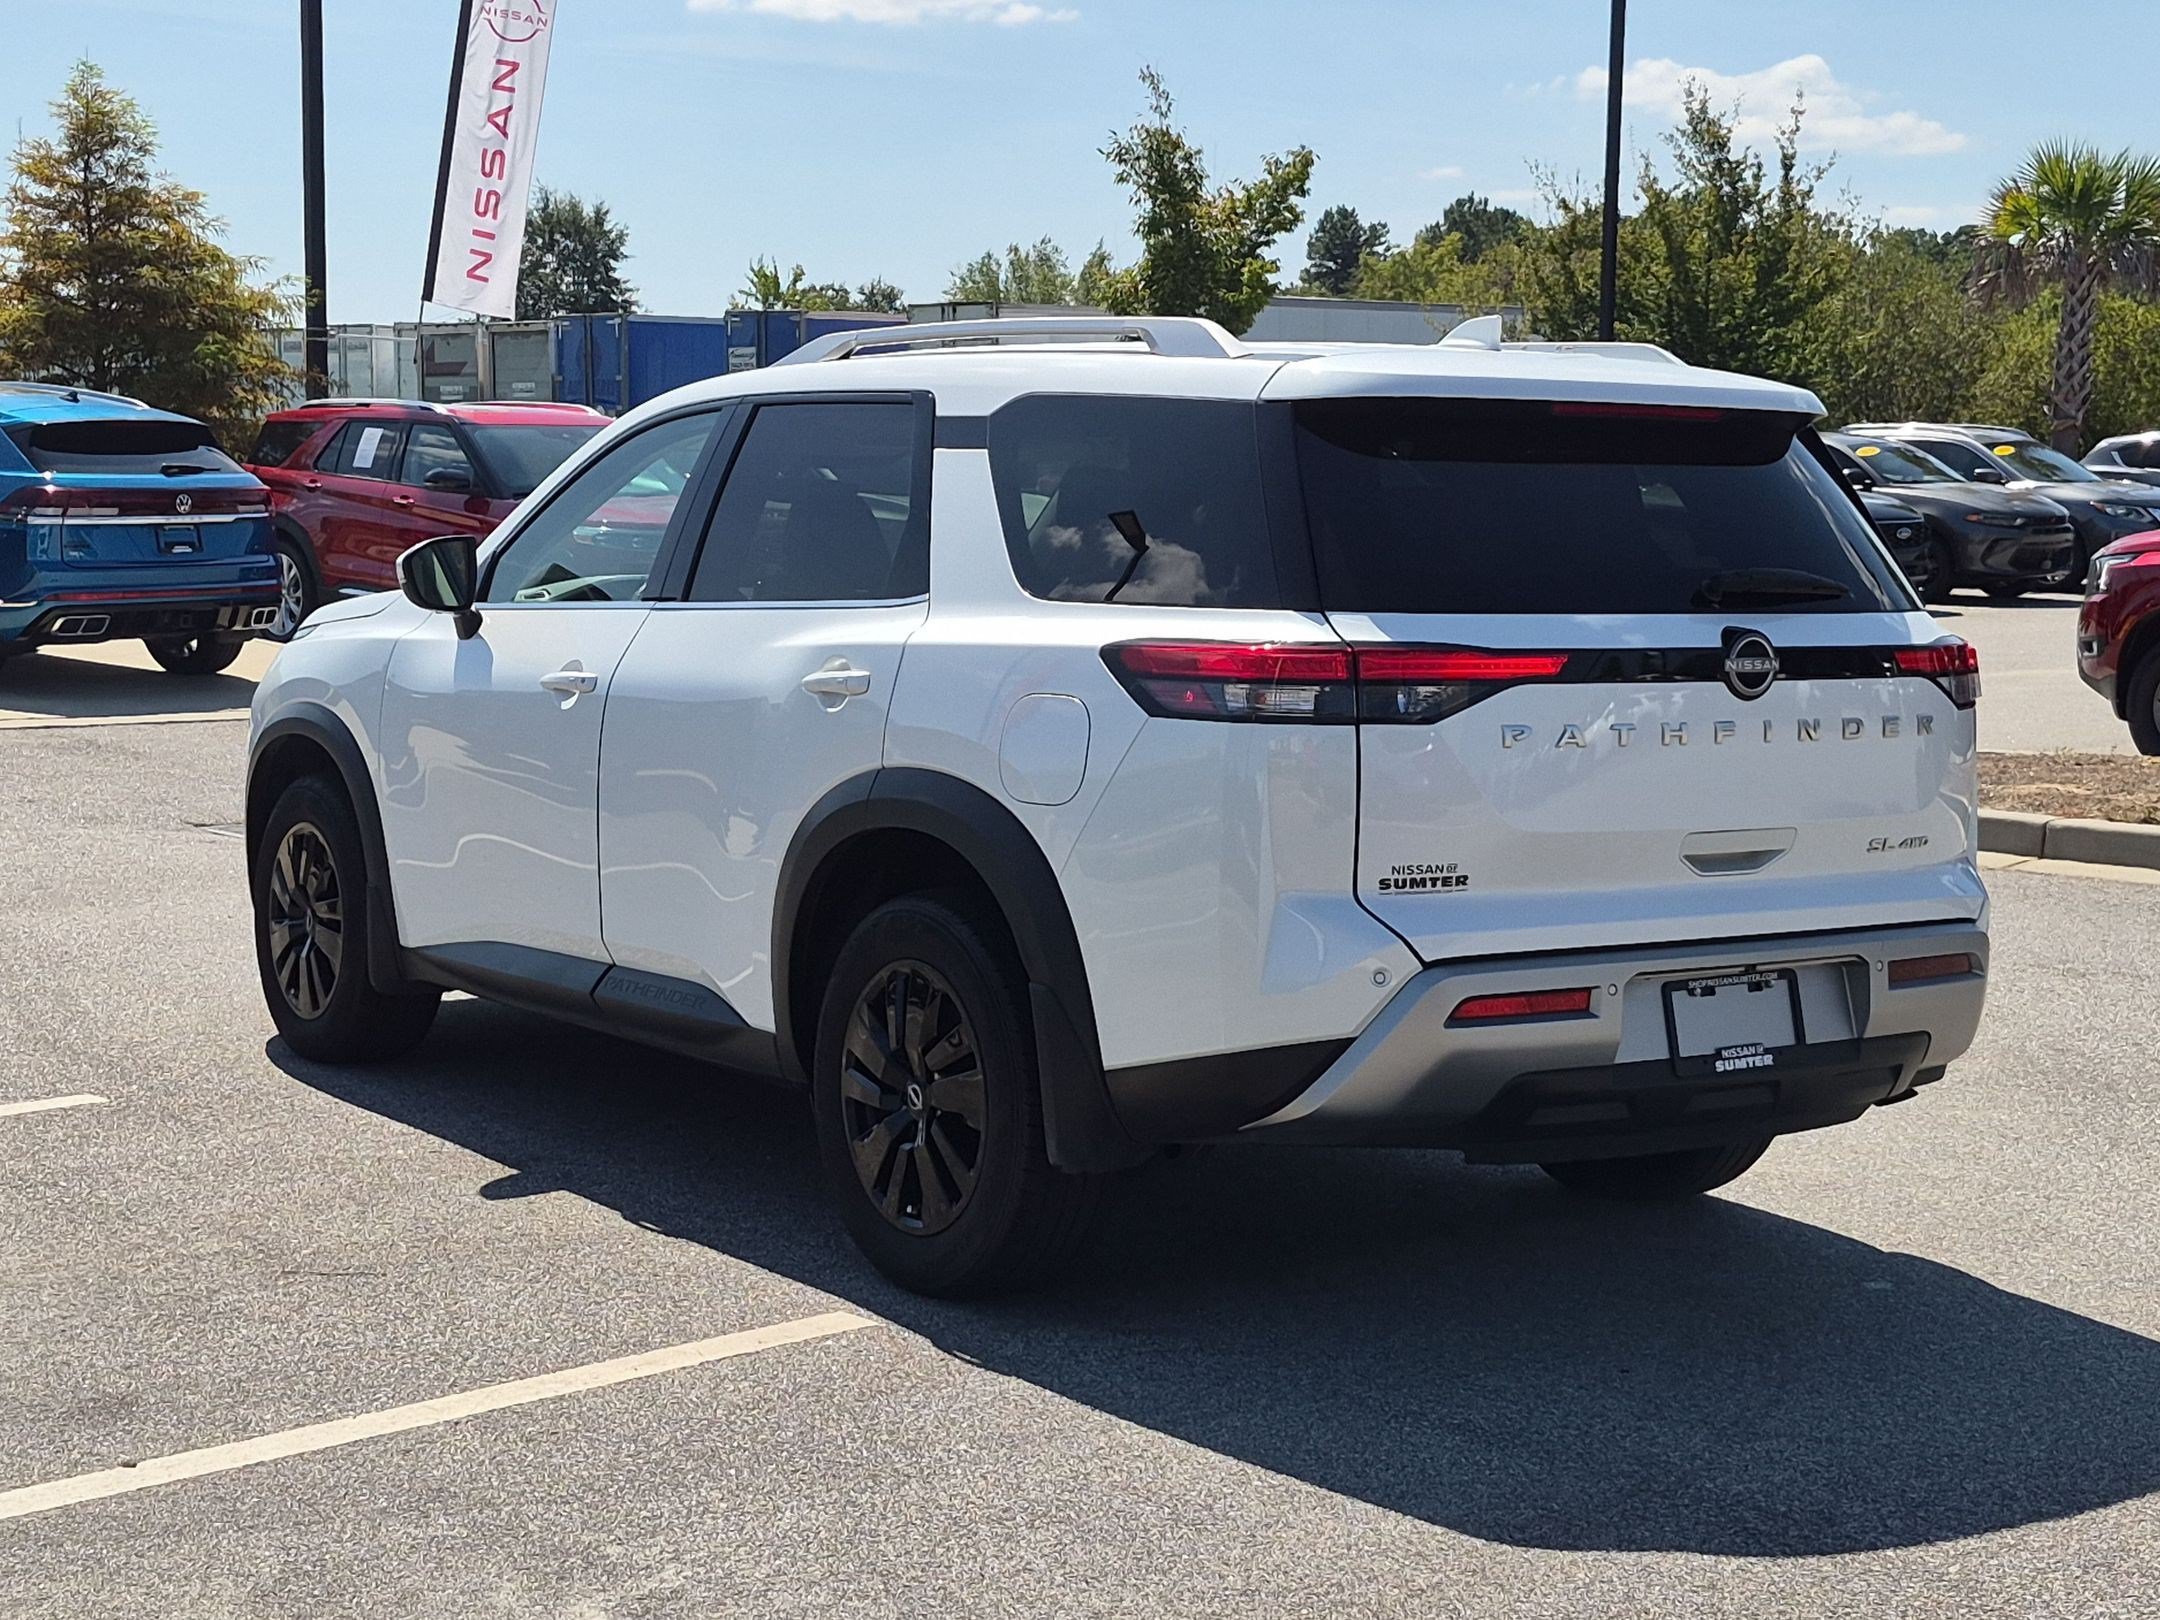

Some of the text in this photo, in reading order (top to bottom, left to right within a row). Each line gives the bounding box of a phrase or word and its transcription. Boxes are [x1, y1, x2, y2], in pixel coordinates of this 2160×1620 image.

[480, 6, 548, 27] NISSAN
[466, 58, 520, 283] NISSAN
[1726, 659, 1779, 671] NISSAN
[1501, 713, 1935, 748] PATHFINDER
[1391, 864, 1445, 876] NISSAN
[1378, 875, 1469, 891] SUMTER
[603, 975, 706, 1009] PATHFINDER
[1721, 1045, 1756, 1059] NISSAN
[1715, 1054, 1774, 1072] SUMTER
